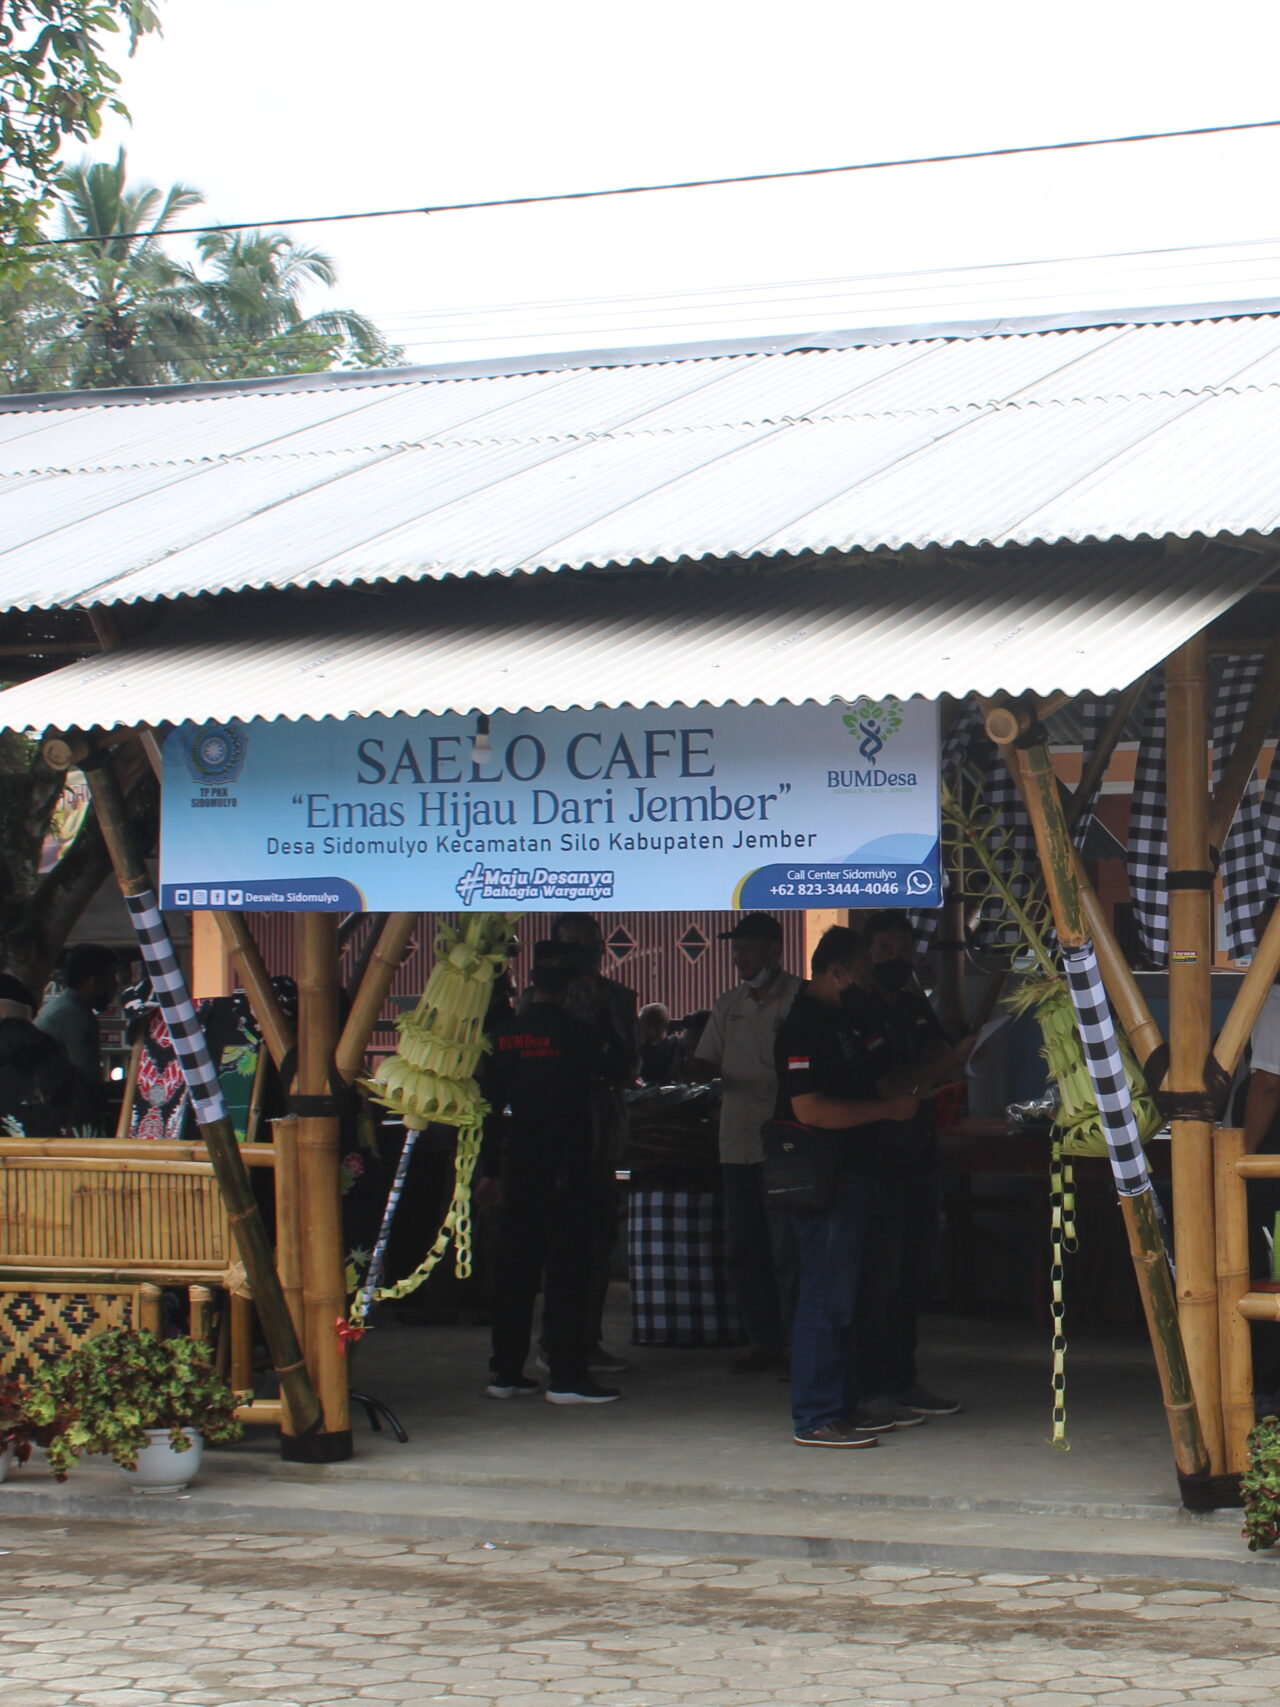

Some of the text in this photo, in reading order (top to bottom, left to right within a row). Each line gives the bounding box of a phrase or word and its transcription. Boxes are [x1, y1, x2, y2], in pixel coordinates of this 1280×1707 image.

[357, 728, 716, 785] SAELO CAFE
[827, 769, 918, 788] BUMDesa
[418, 791, 517, 838] Hijau
[532, 788, 615, 825] Dari
[267, 830, 817, 858] Desa Sidomulyo Kecamatan Silo Kabupaten Jember
[532, 868, 614, 887] Desanya
[787, 869, 897, 882] Call Center Sidomulyo
[245, 892, 339, 904] Deswita Sidomulyo
[482, 885, 614, 901] Bahagia Warganya
[770, 883, 899, 896] +62 823-3444-4046
